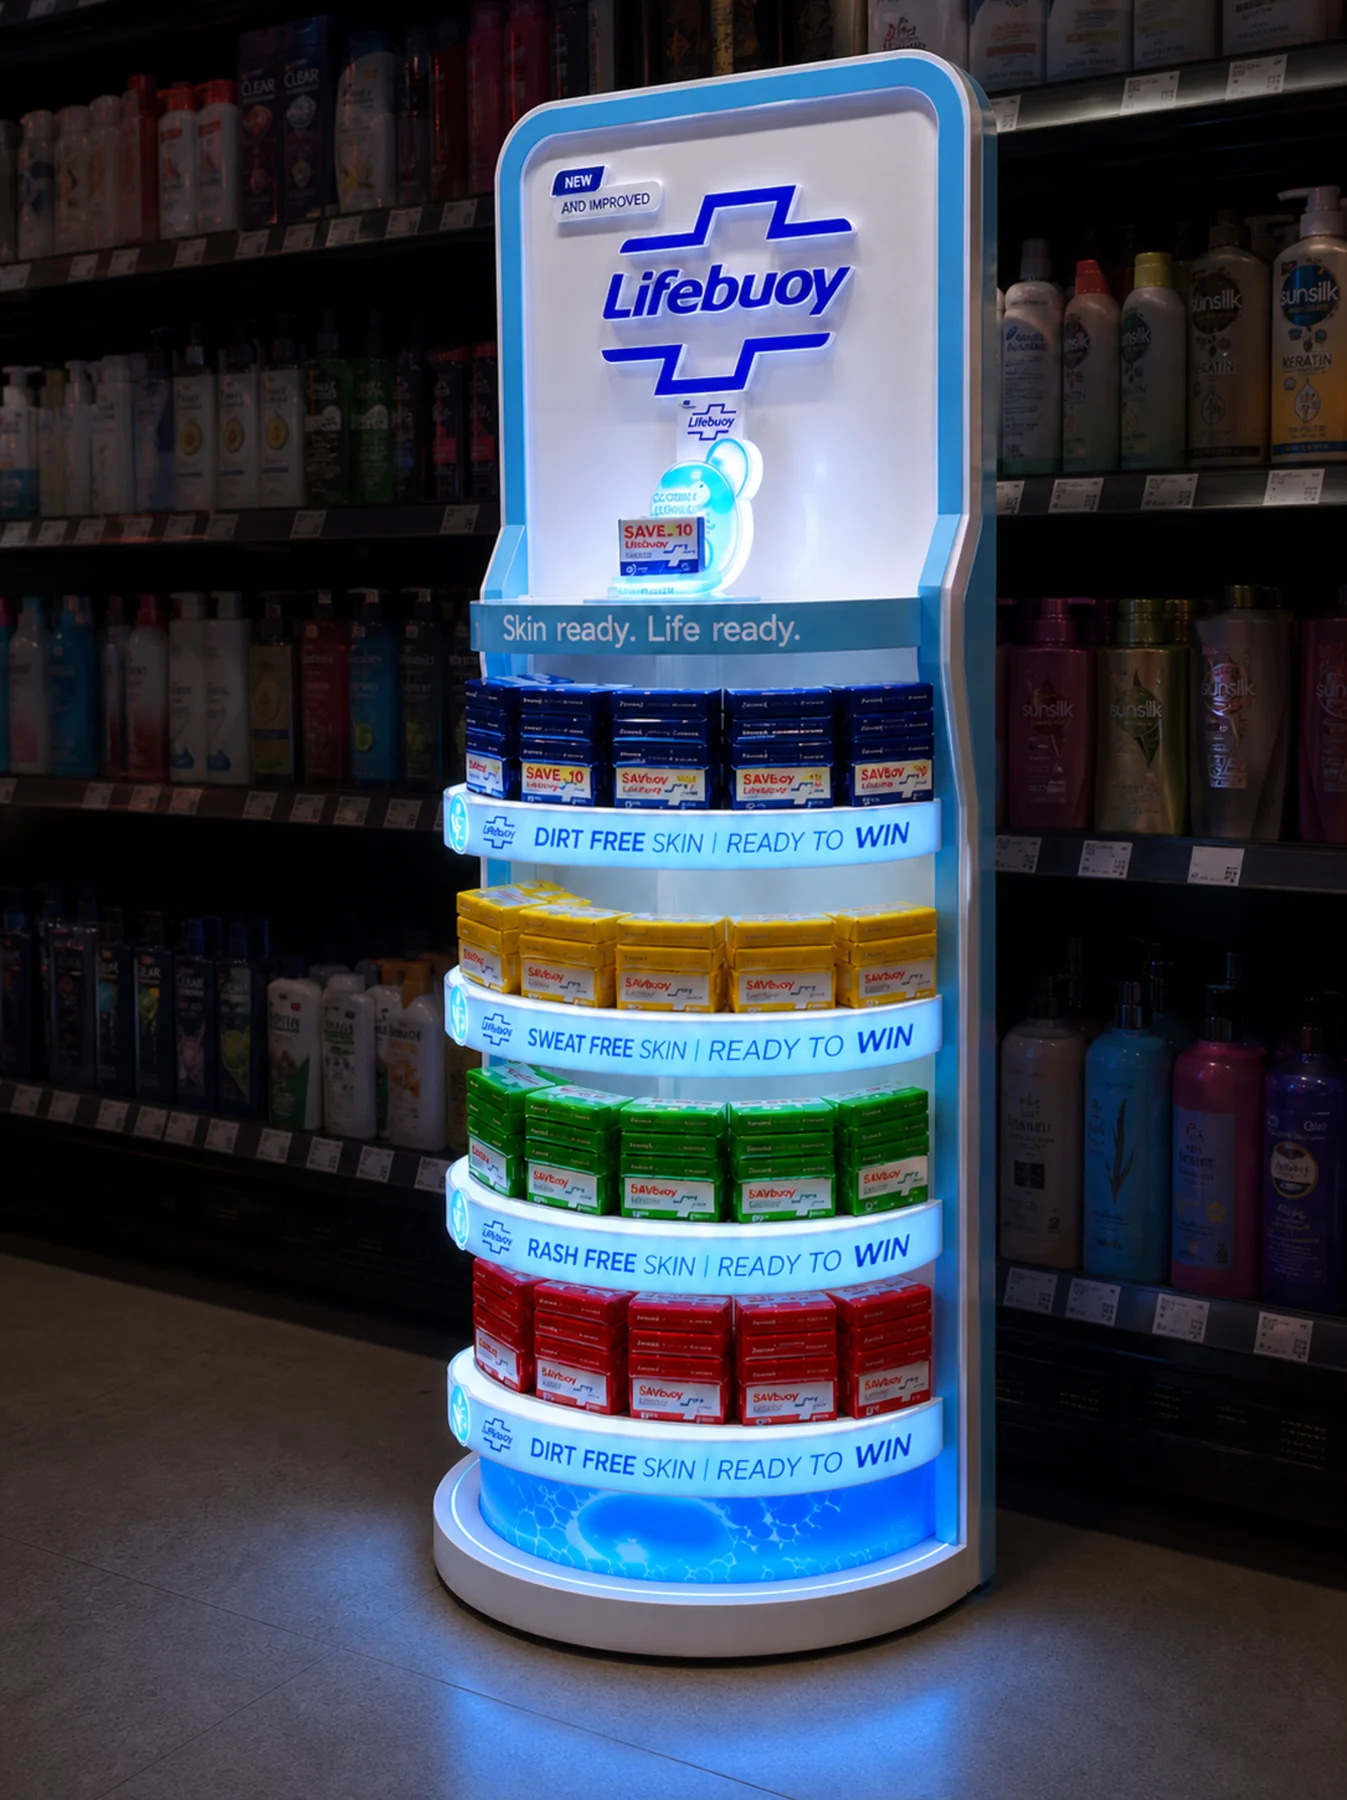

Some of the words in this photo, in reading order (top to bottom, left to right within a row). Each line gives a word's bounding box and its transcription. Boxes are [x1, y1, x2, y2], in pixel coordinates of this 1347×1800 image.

[564, 174, 593, 189] NEW
[561, 200, 587, 215] AND
[589, 192, 650, 211] IMPROVED
[602, 263, 853, 320] Lifebuoy
[1281, 280, 1340, 306] sunsilk
[1282, 353, 1334, 370] KERATIN
[503, 614, 547, 641] Skin
[556, 614, 637, 648] ready.
[647, 614, 701, 642] Life
[712, 613, 800, 647] ready.
[1022, 700, 1074, 718] sunsilk
[1109, 700, 1163, 718] sunsilk
[526, 766, 561, 782] SAVE
[535, 826, 584, 849] DIRT
[590, 830, 646, 852] FREE
[652, 832, 704, 854] SKIN
[727, 831, 806, 853] READY
[813, 829, 844, 851] TO
[855, 821, 910, 849] WIN
[528, 1027, 587, 1054] SWEAT
[589, 1035, 635, 1059] FREE
[639, 1039, 688, 1061] SKIN
[708, 1037, 801, 1062] READY
[808, 1034, 844, 1058] TO
[857, 1023, 914, 1054] WIN
[527, 1237, 579, 1266] RASH
[583, 1248, 637, 1274] FREE
[643, 1253, 696, 1277] SKIN
[717, 1252, 802, 1278] READY
[808, 1249, 843, 1274] TO
[854, 1233, 911, 1269] WIN
[530, 1437, 577, 1466] DIRT
[582, 1449, 637, 1476] FREE
[642, 1456, 696, 1480] SKIN
[717, 1455, 802, 1480] READY
[809, 1451, 844, 1476] TO
[855, 1432, 912, 1469] WIN
